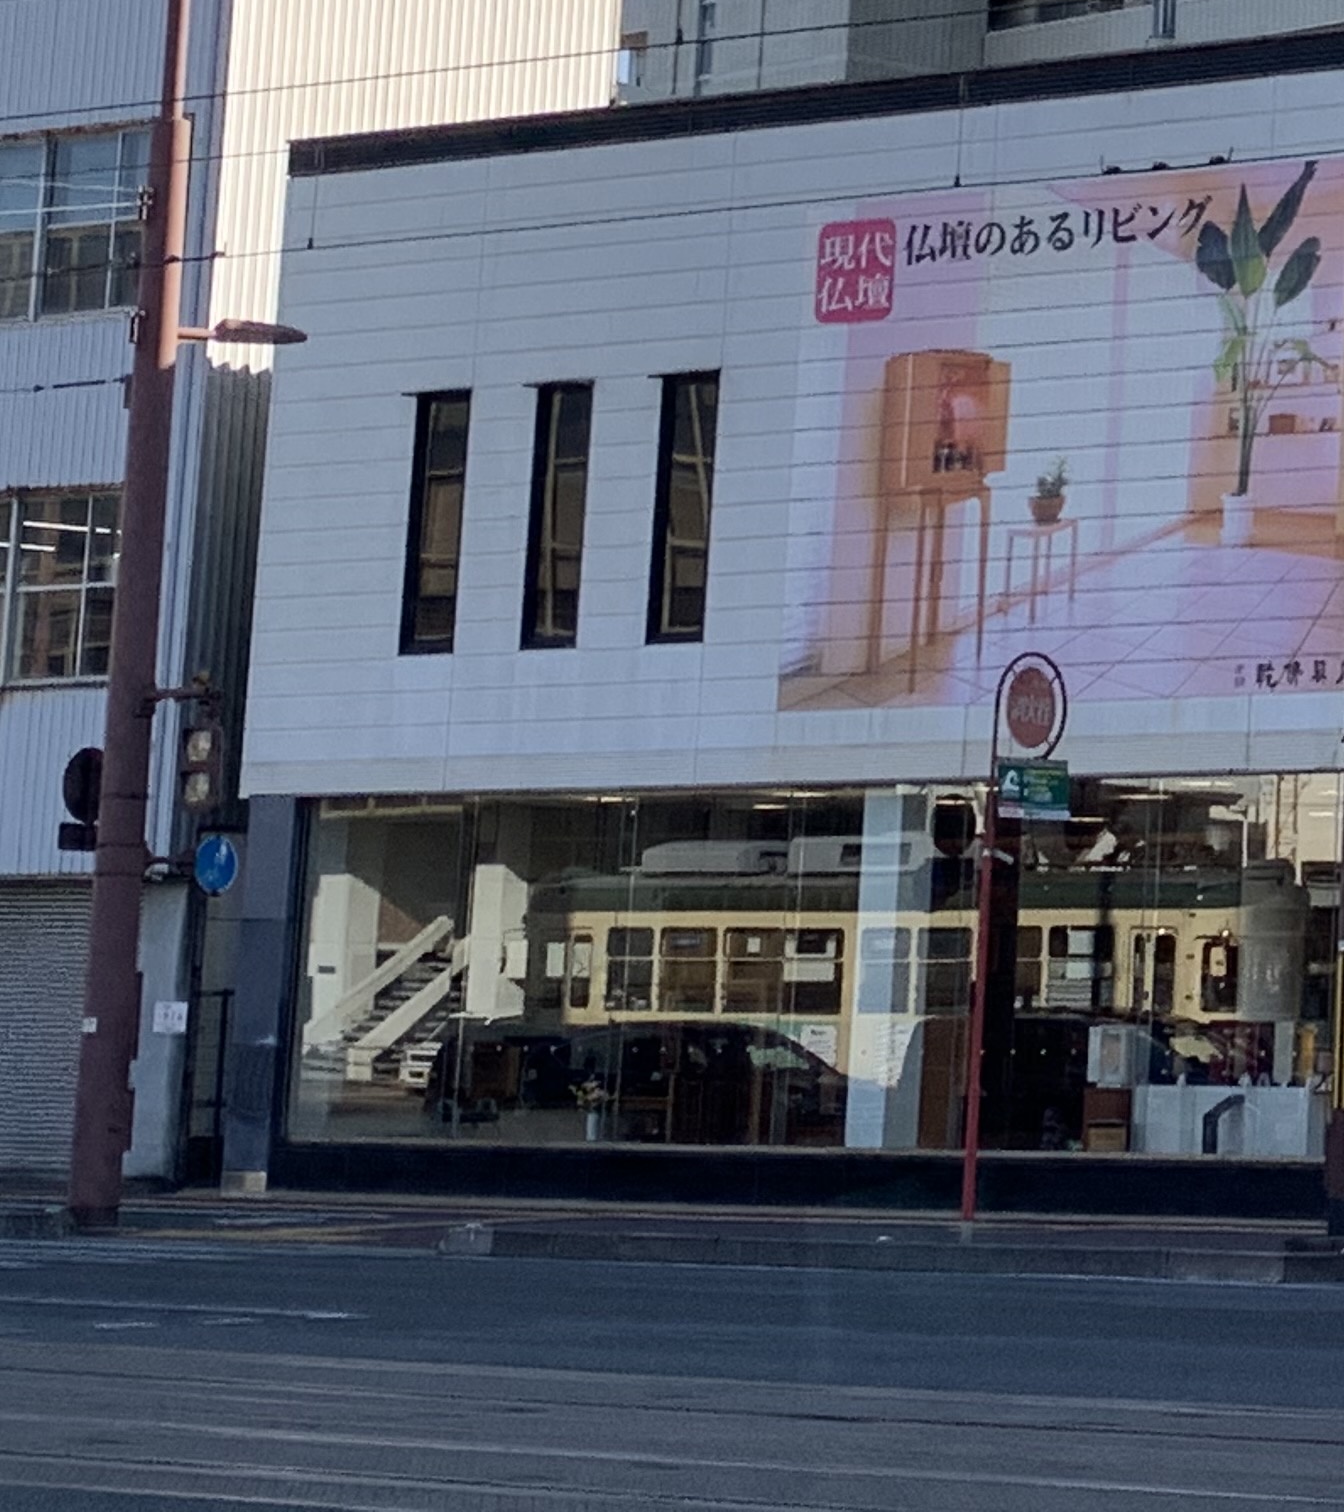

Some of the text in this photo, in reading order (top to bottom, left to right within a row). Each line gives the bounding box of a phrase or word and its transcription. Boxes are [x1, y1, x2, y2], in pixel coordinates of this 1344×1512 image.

[902, 194, 1213, 266] 仏壇のあるリビング
[820, 232, 894, 271] 現代
[817, 274, 892, 314] 仏壇
